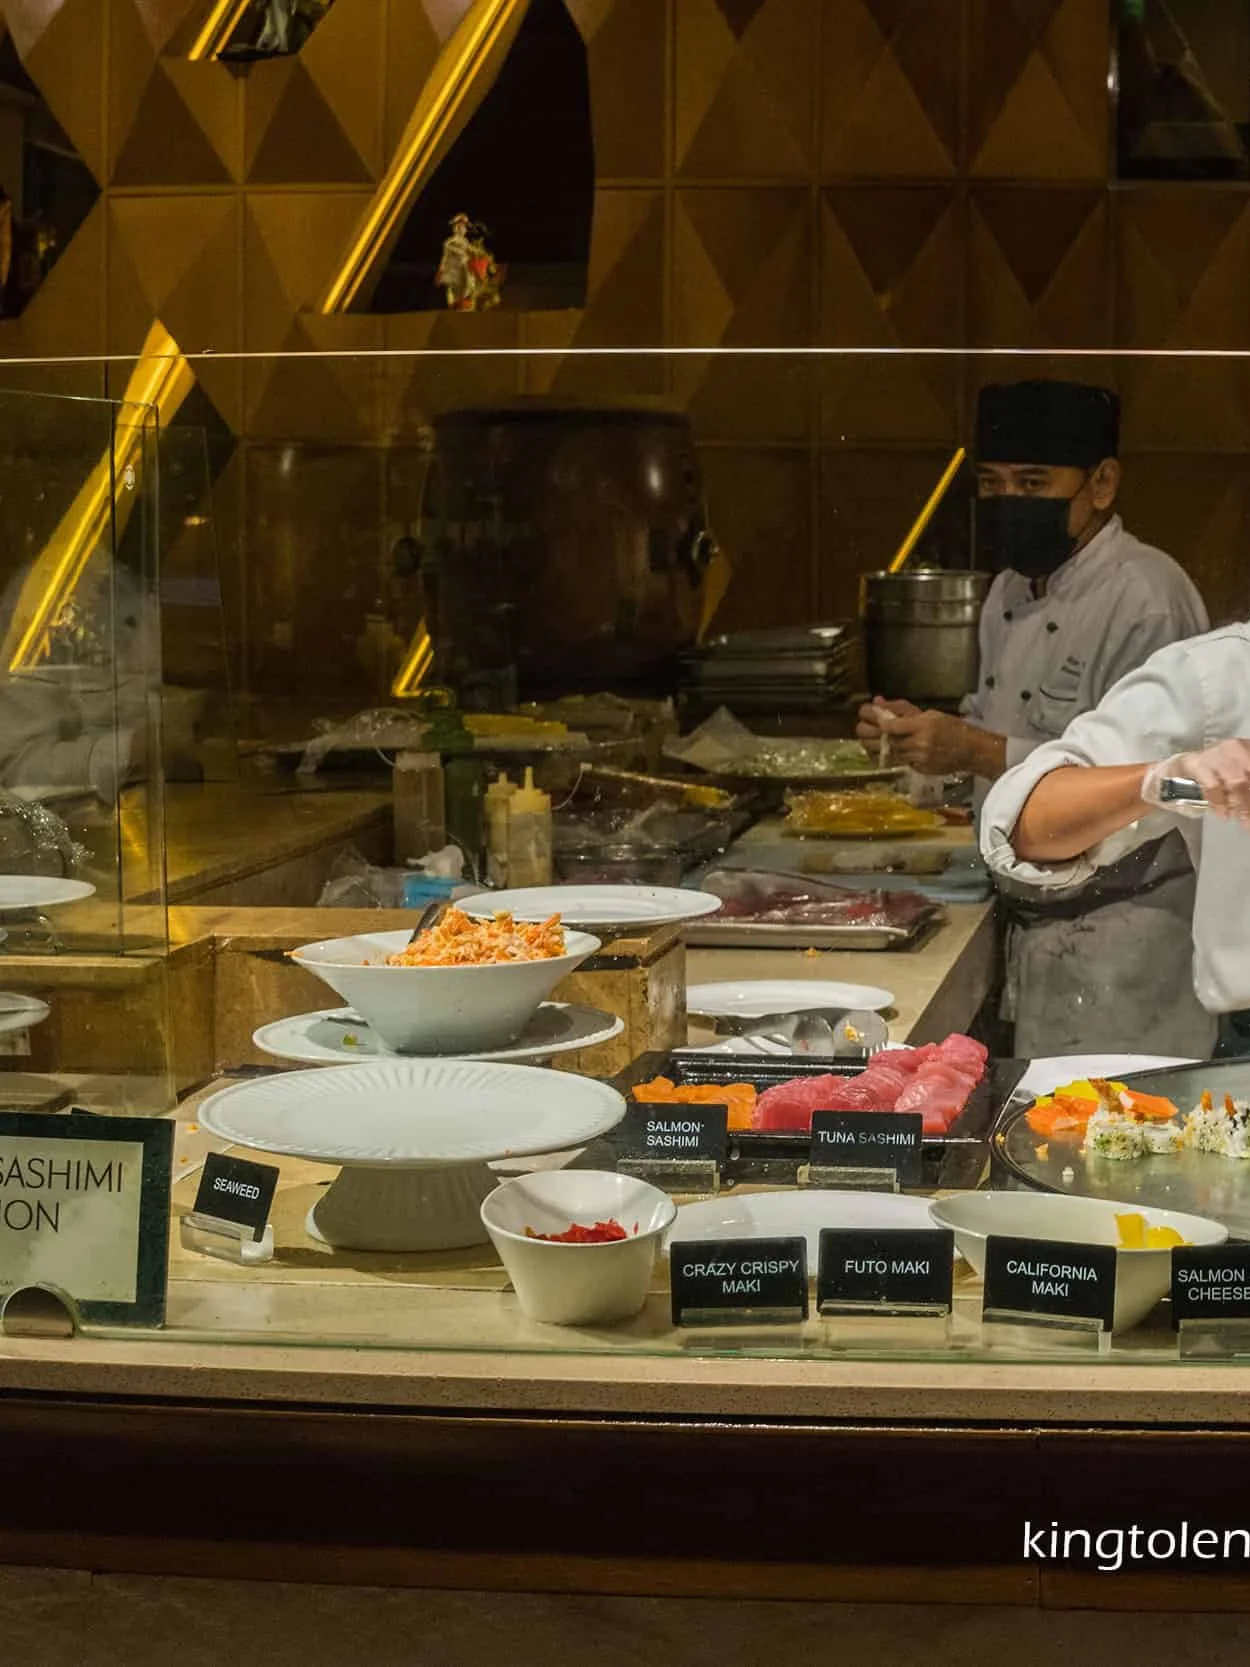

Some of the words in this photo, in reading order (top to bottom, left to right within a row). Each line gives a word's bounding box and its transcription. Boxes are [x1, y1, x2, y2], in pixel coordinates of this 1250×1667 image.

[646, 1120, 701, 1133] SALMON
[646, 1134, 699, 1148] SASHIMI
[818, 1130, 856, 1144] TUNA
[858, 1132, 915, 1146] SASHIMI
[0, 1155, 122, 1193] ASHIMI
[213, 1177, 260, 1200] SEAWEED
[0, 1200, 59, 1233] ON
[682, 1262, 737, 1277] CRAZY
[740, 1259, 800, 1275] CRISPY
[844, 1260, 887, 1275] FUTO
[891, 1260, 930, 1275] MAKI
[1006, 1260, 1098, 1281] CALIFORNIA
[1177, 1269, 1245, 1283] SALMON
[722, 1279, 761, 1294] MAKI
[1031, 1280, 1069, 1297] MAKI
